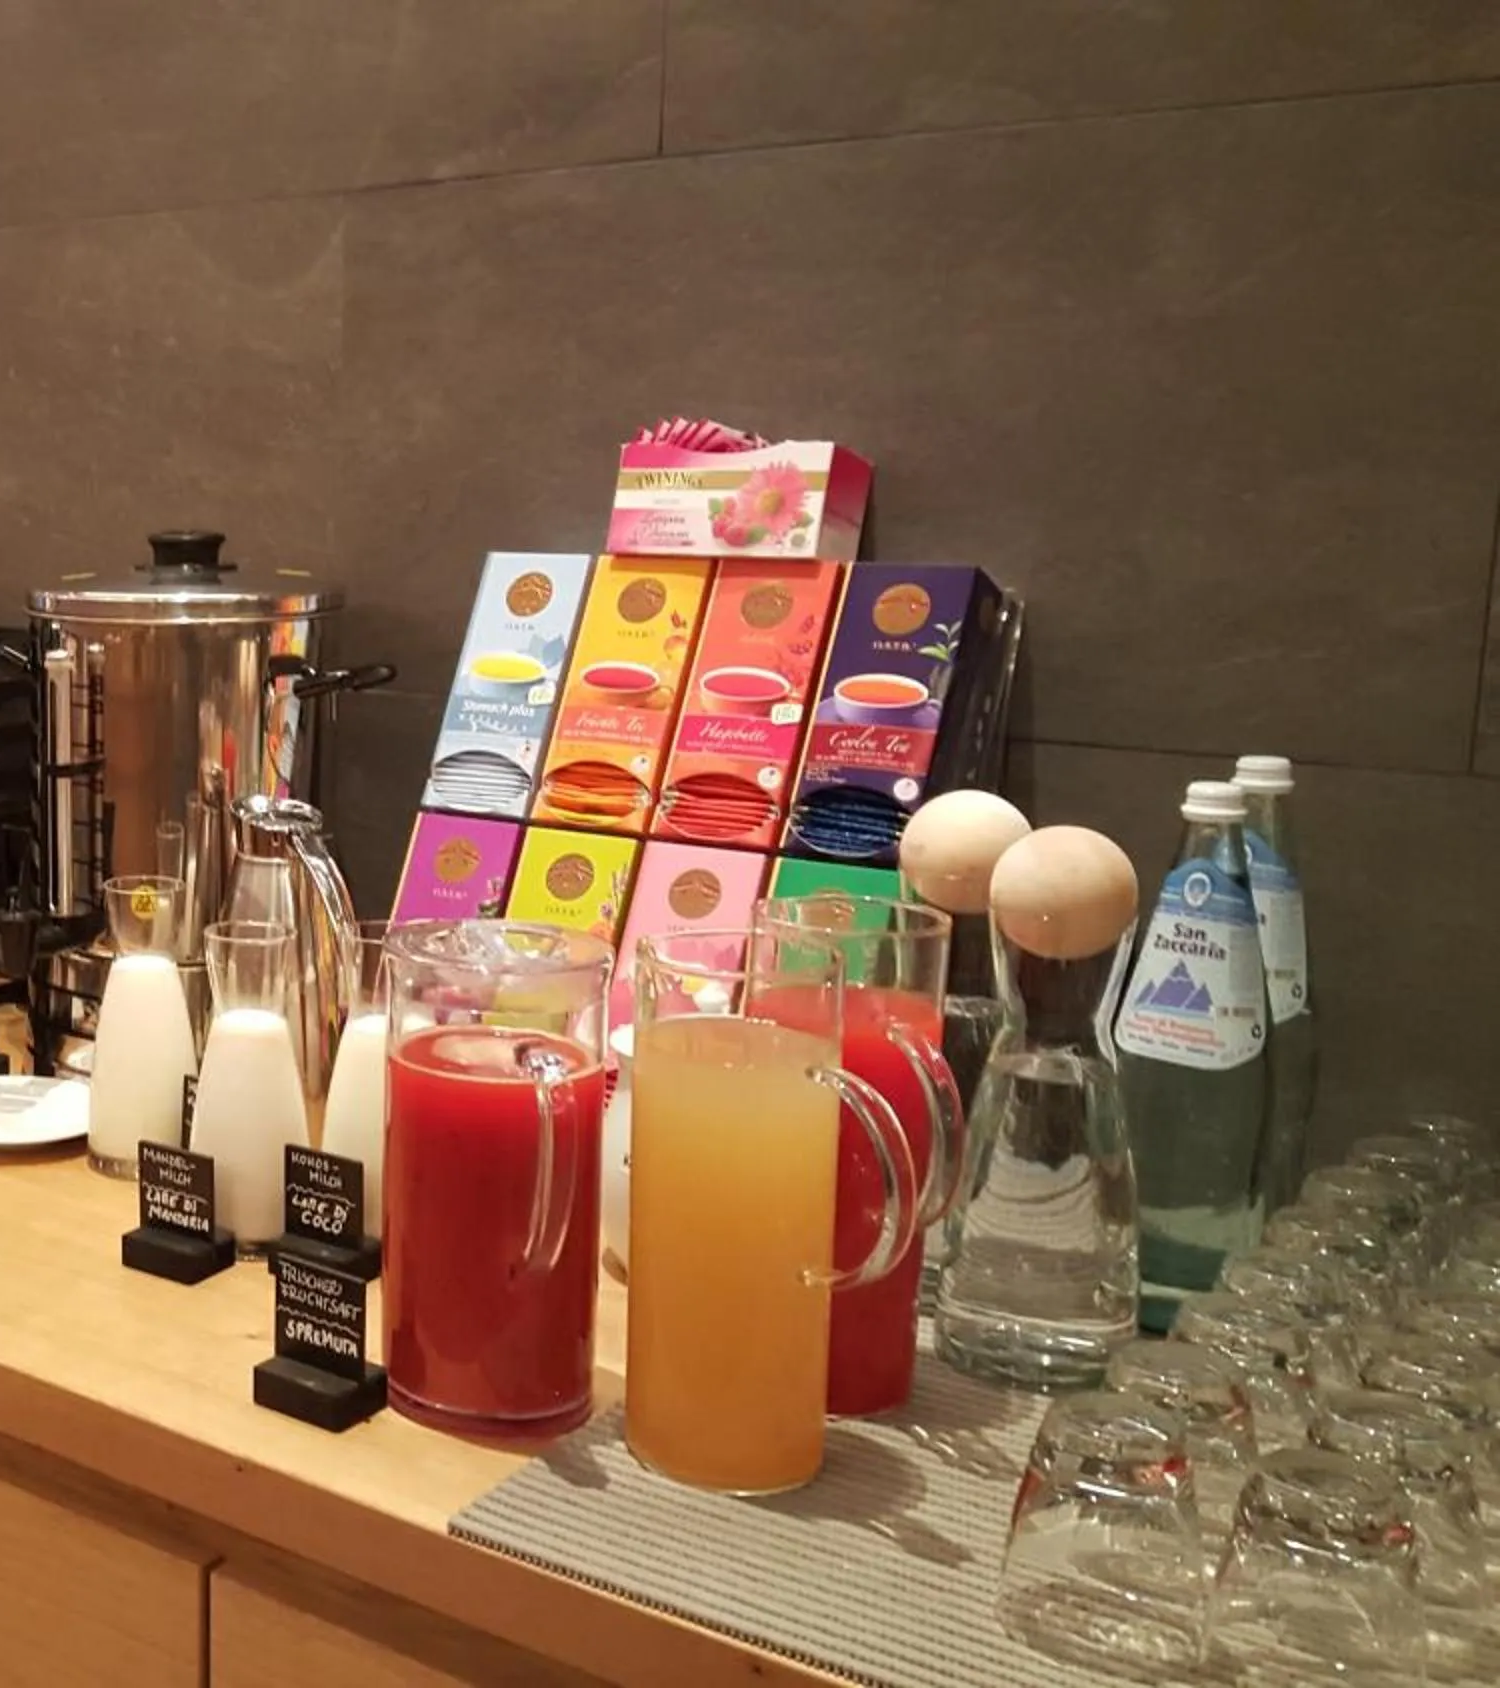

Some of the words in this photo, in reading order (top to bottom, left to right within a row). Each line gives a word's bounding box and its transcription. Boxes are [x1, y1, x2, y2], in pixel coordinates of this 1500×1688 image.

[636, 471, 703, 489] TWININGS
[1173, 922, 1207, 941] San
[1153, 933, 1227, 961] Zaccaria
[301, 1210, 343, 1235] COCO
[285, 1319, 358, 1357] SPREMUTA
